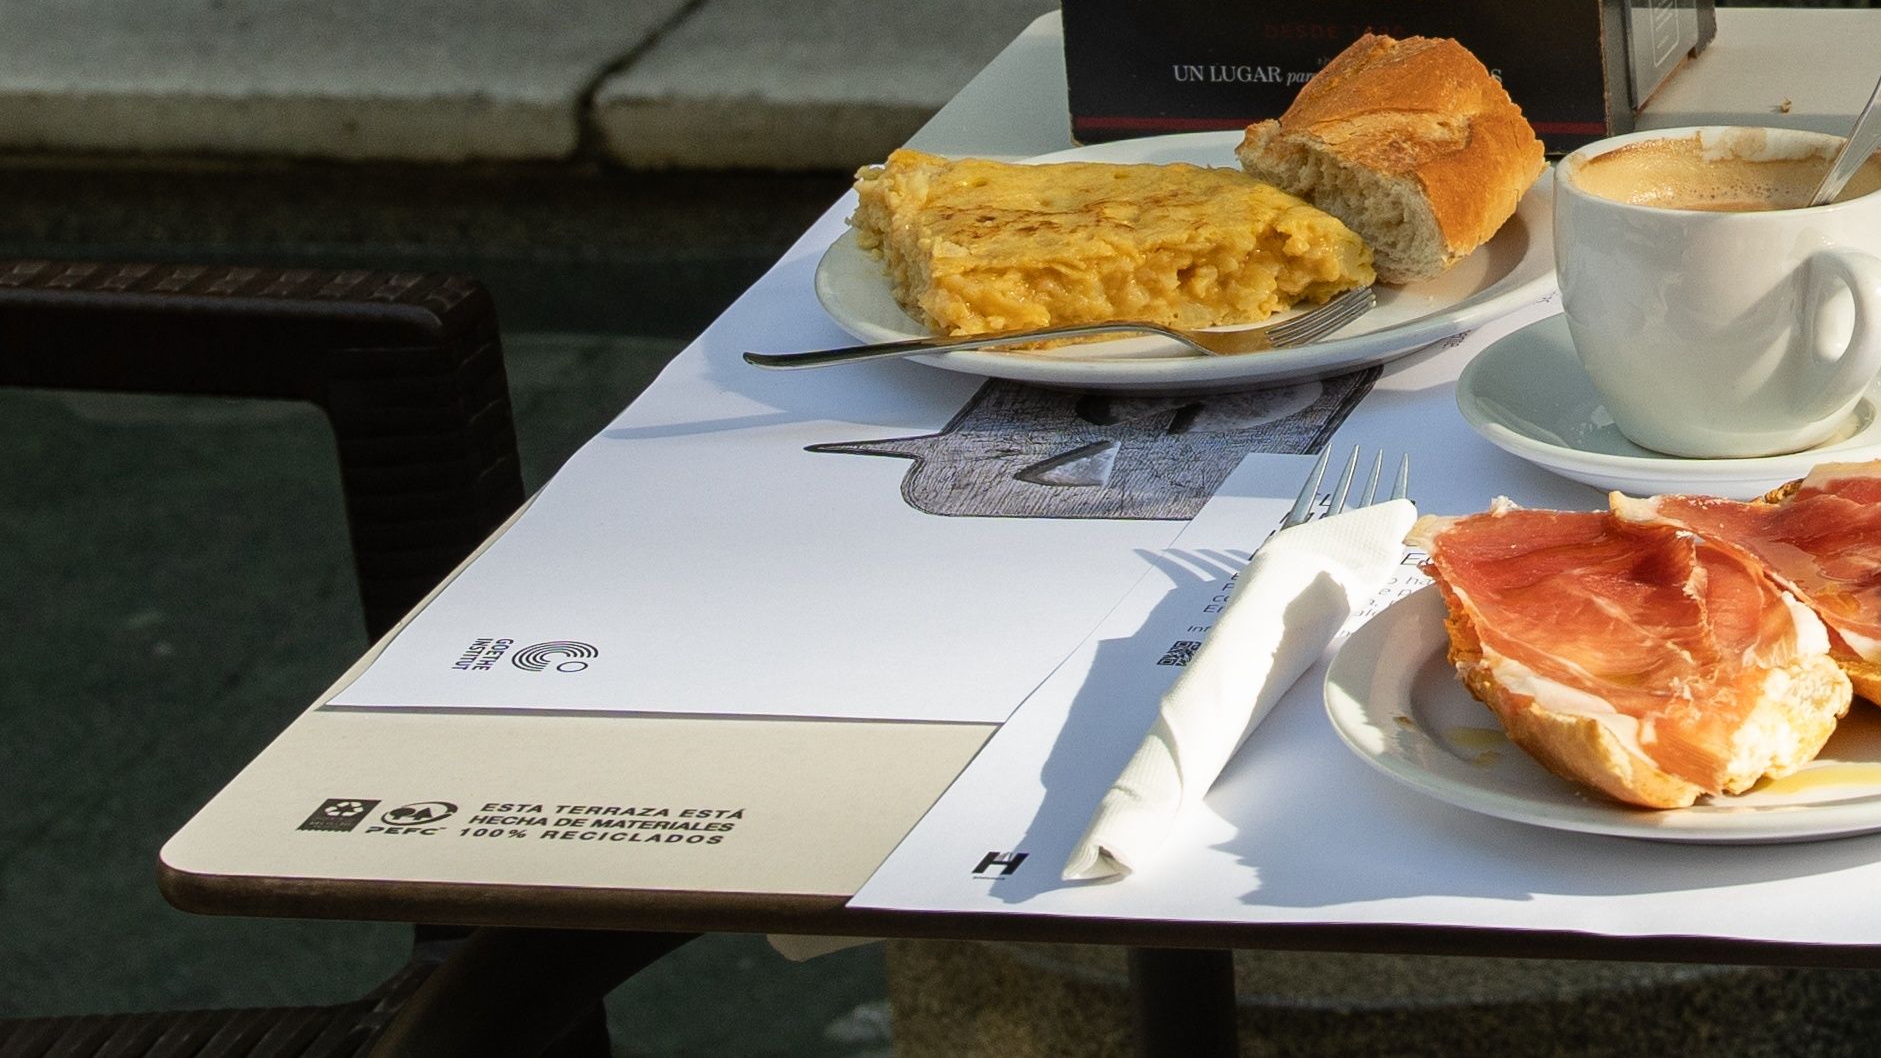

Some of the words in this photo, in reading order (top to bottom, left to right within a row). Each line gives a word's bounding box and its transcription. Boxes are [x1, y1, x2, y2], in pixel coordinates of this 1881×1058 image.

[1172, 64, 1205, 82] UN
[1210, 64, 1284, 82] LUGAR
[1286, 71, 1316, 86] par
[452, 638, 494, 670] INSTITUT
[472, 638, 514, 671] GOETHE
[480, 802, 544, 814] ESTA
[555, 804, 670, 818] TERRAZA
[678, 808, 747, 820] ESTÁ
[365, 826, 439, 836] PEFC
[468, 815, 548, 827] HECHA
[553, 817, 590, 828] DE
[590, 819, 736, 832] MATERIALES
[458, 827, 527, 839] 100%
[540, 830, 726, 844] RECICLADOS
